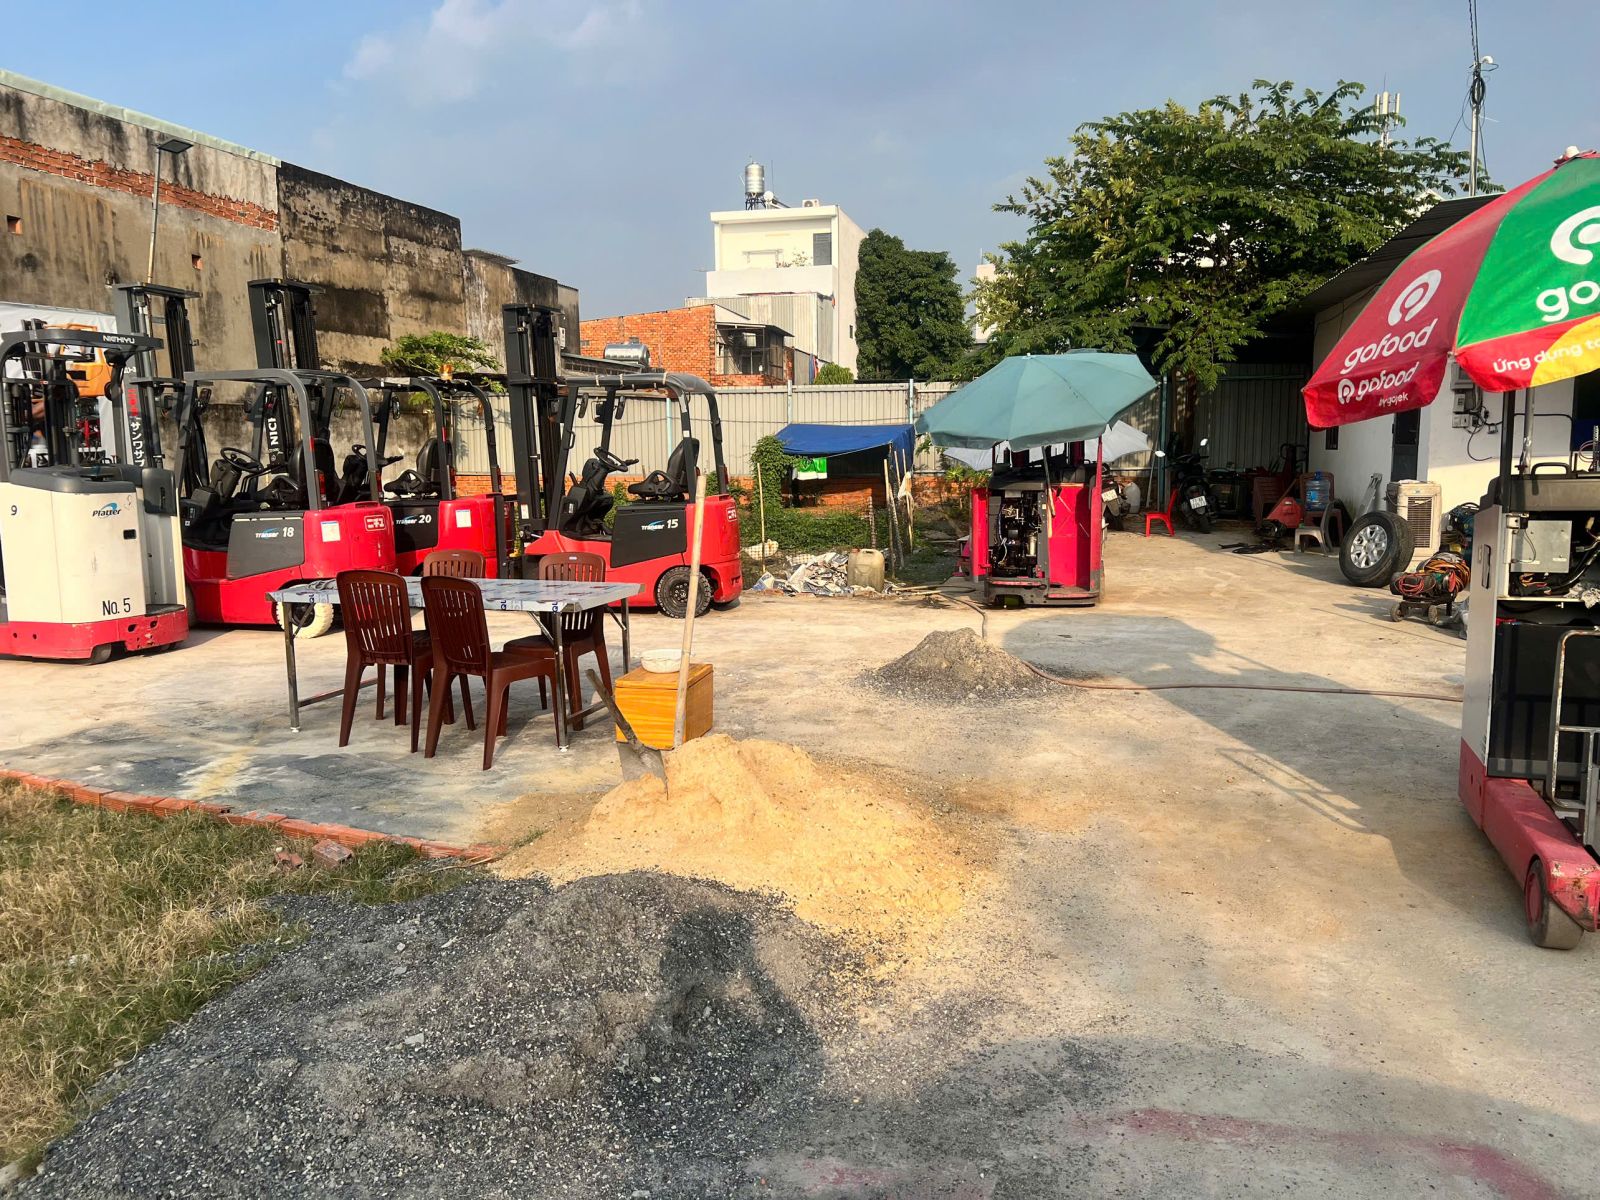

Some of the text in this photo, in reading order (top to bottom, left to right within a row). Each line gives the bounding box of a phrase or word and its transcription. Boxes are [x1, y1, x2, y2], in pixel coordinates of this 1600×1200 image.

[1340, 318, 1438, 375] gofood
[1493, 358, 1531, 373] Ứng
[1355, 361, 1419, 401] gofood
[11, 505, 18, 516] 9
[92, 506, 121, 517] Platter
[418, 514, 432, 524] 20
[667, 519, 679, 528] 15
[282, 527, 295, 538] 18
[102, 598, 131, 616] No. 5
